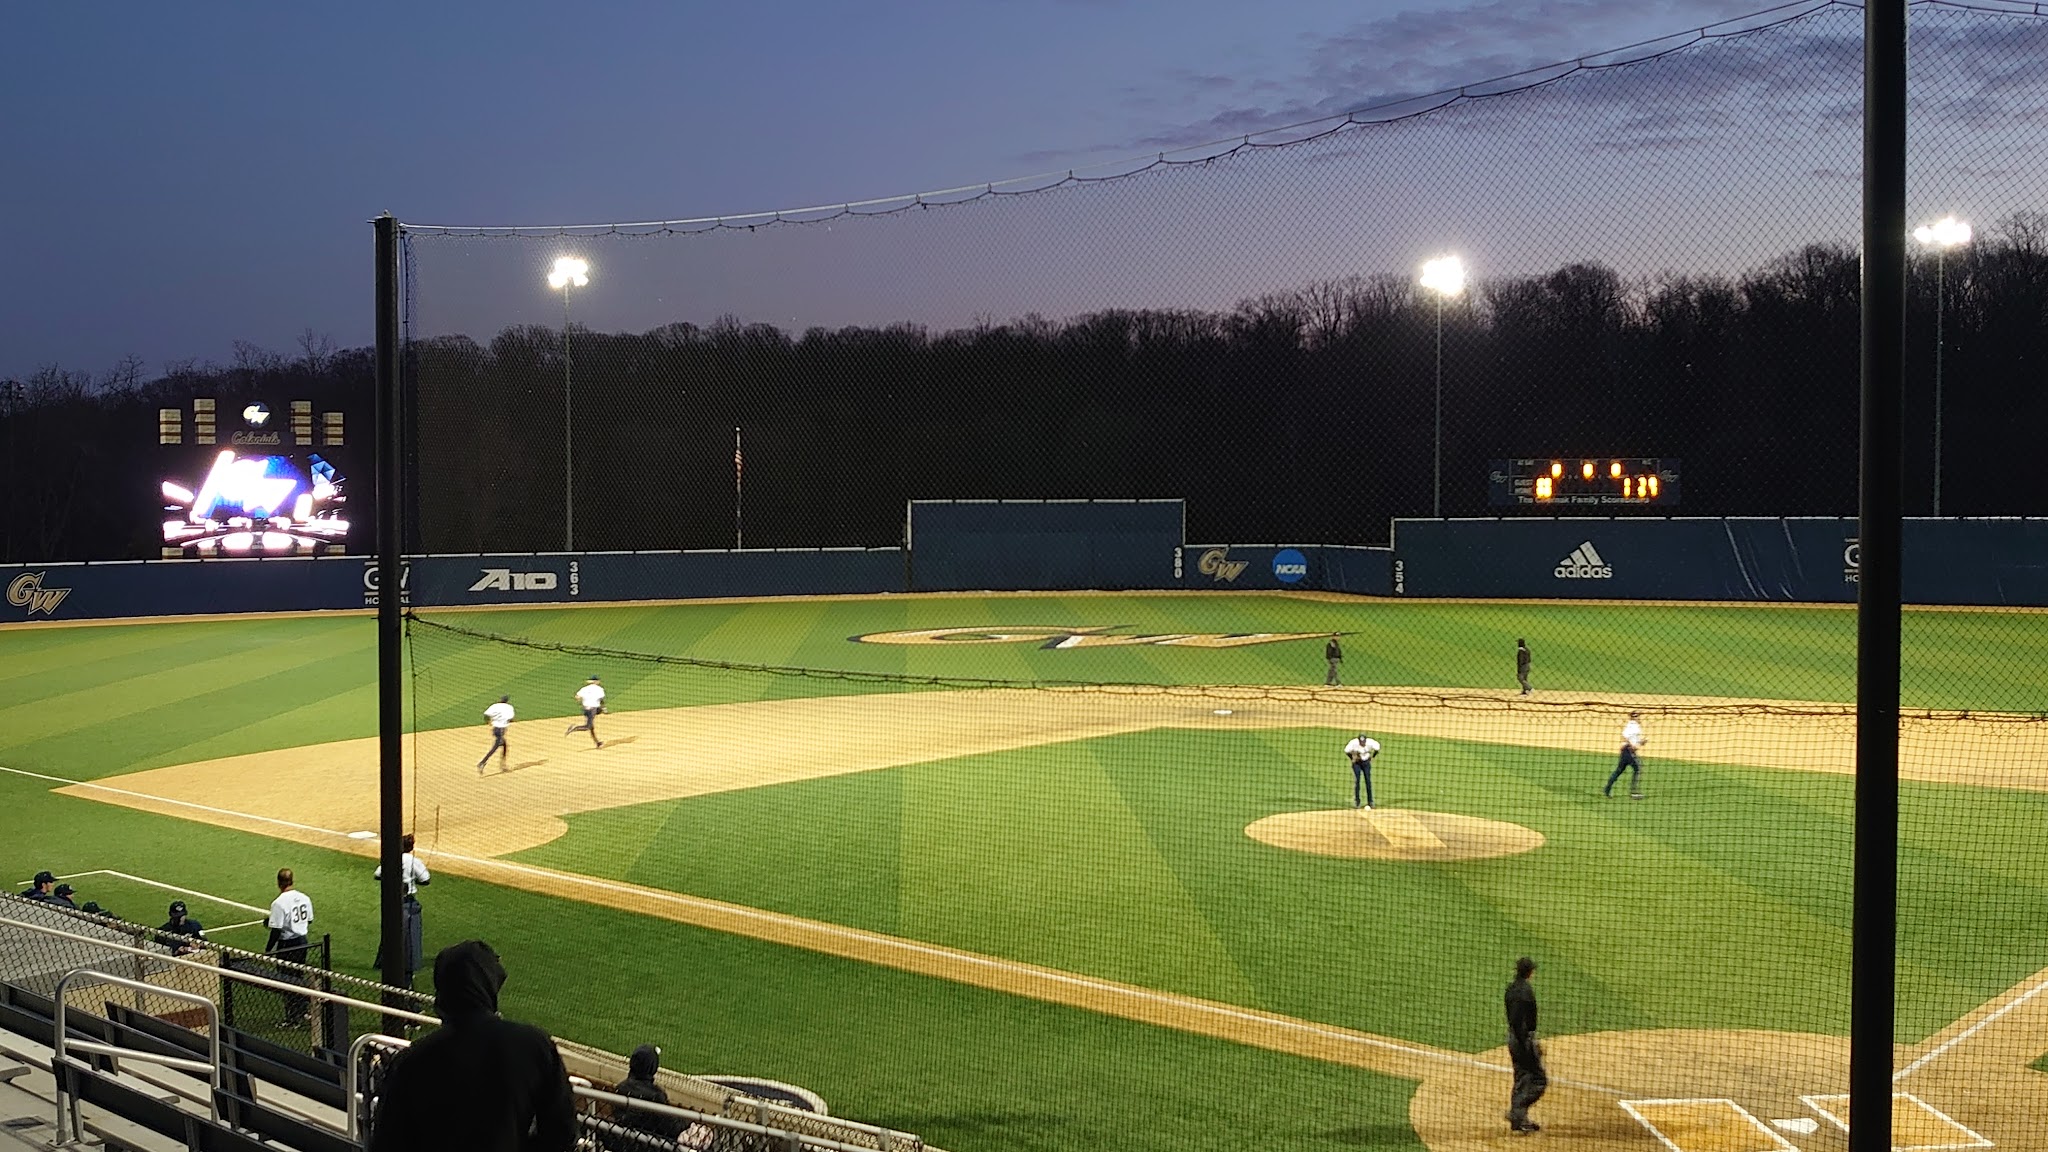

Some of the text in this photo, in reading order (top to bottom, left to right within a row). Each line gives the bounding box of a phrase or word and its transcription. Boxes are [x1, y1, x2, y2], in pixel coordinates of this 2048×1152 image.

[231, 430, 281, 445] Colonials
[1571, 496, 1599, 505] Family
[1173, 546, 1183, 579] 380
[1197, 546, 1249, 583] GW
[1275, 564, 1307, 575] NCAA
[1553, 563, 1612, 580] adidas
[468, 568, 558, 592] A10
[569, 561, 579, 596] 363
[1395, 560, 1404, 594] 354
[6, 570, 73, 616] GW
[291, 903, 308, 924] 36
